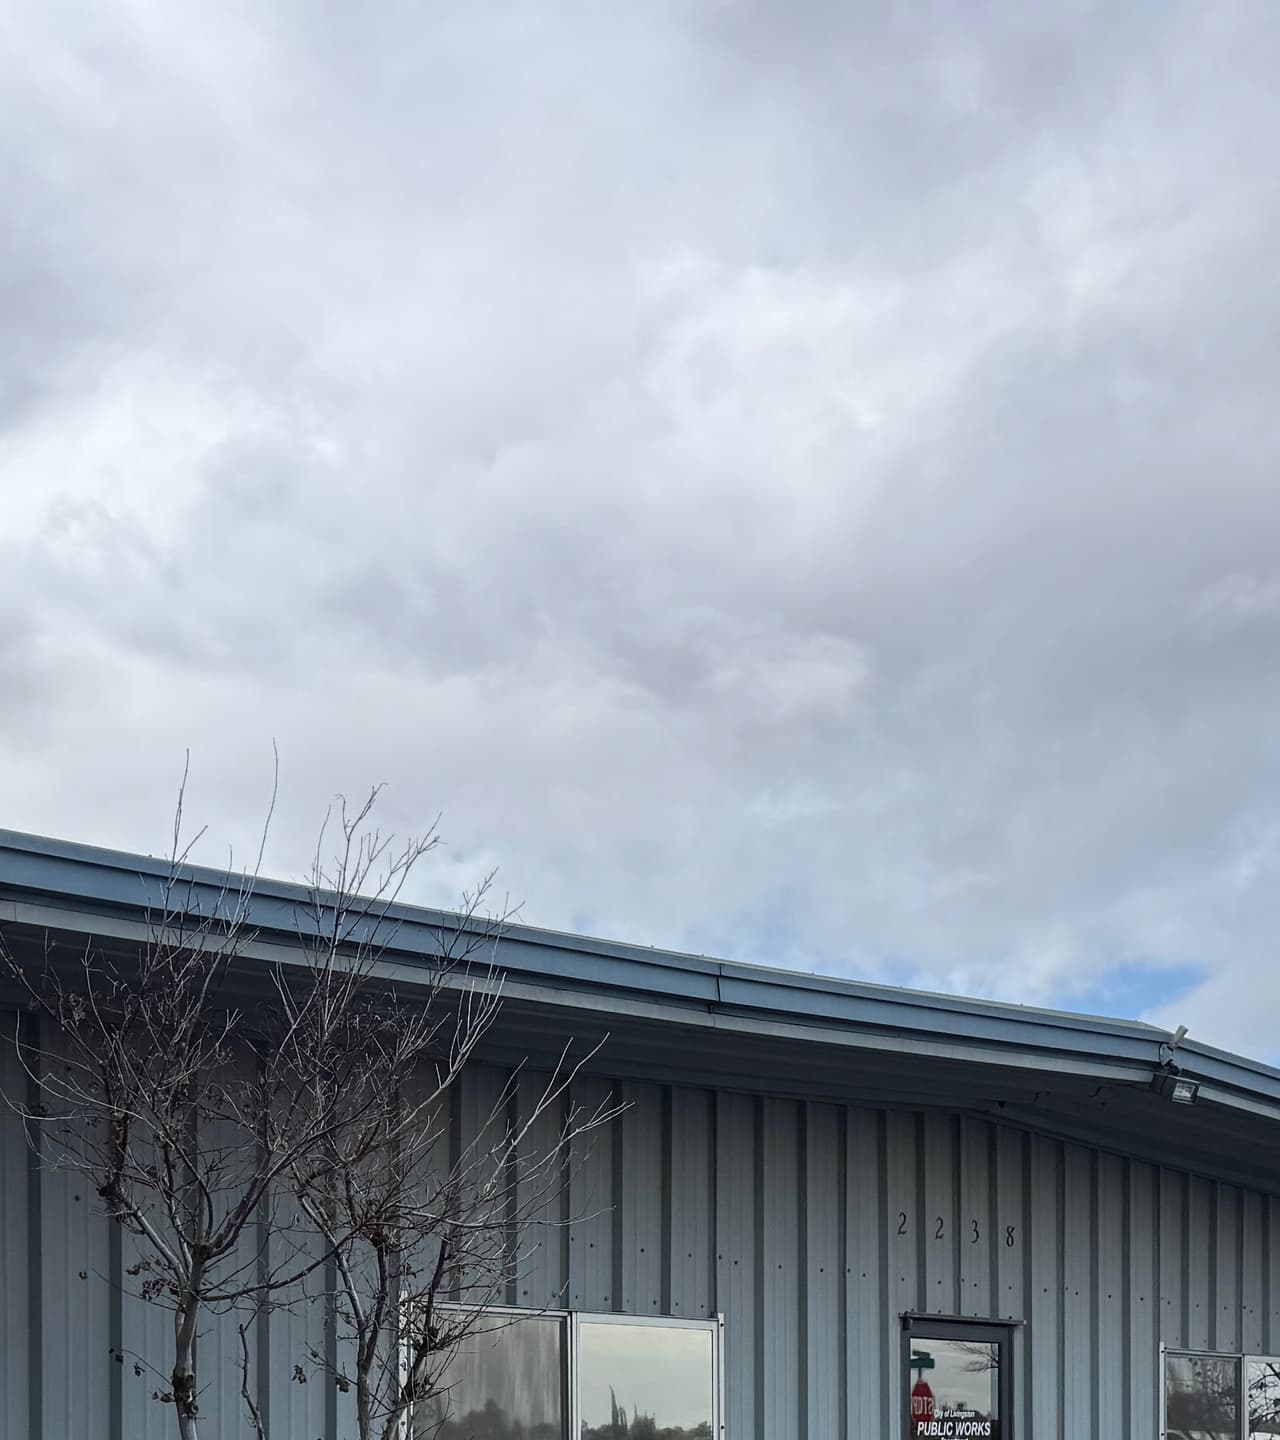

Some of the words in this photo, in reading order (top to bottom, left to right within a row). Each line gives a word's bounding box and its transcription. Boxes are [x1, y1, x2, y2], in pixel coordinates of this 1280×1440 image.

[897, 1212, 1015, 1247] 2238
[917, 1421, 953, 1436] PUBLIC
[955, 1422, 991, 1436] WORKS
